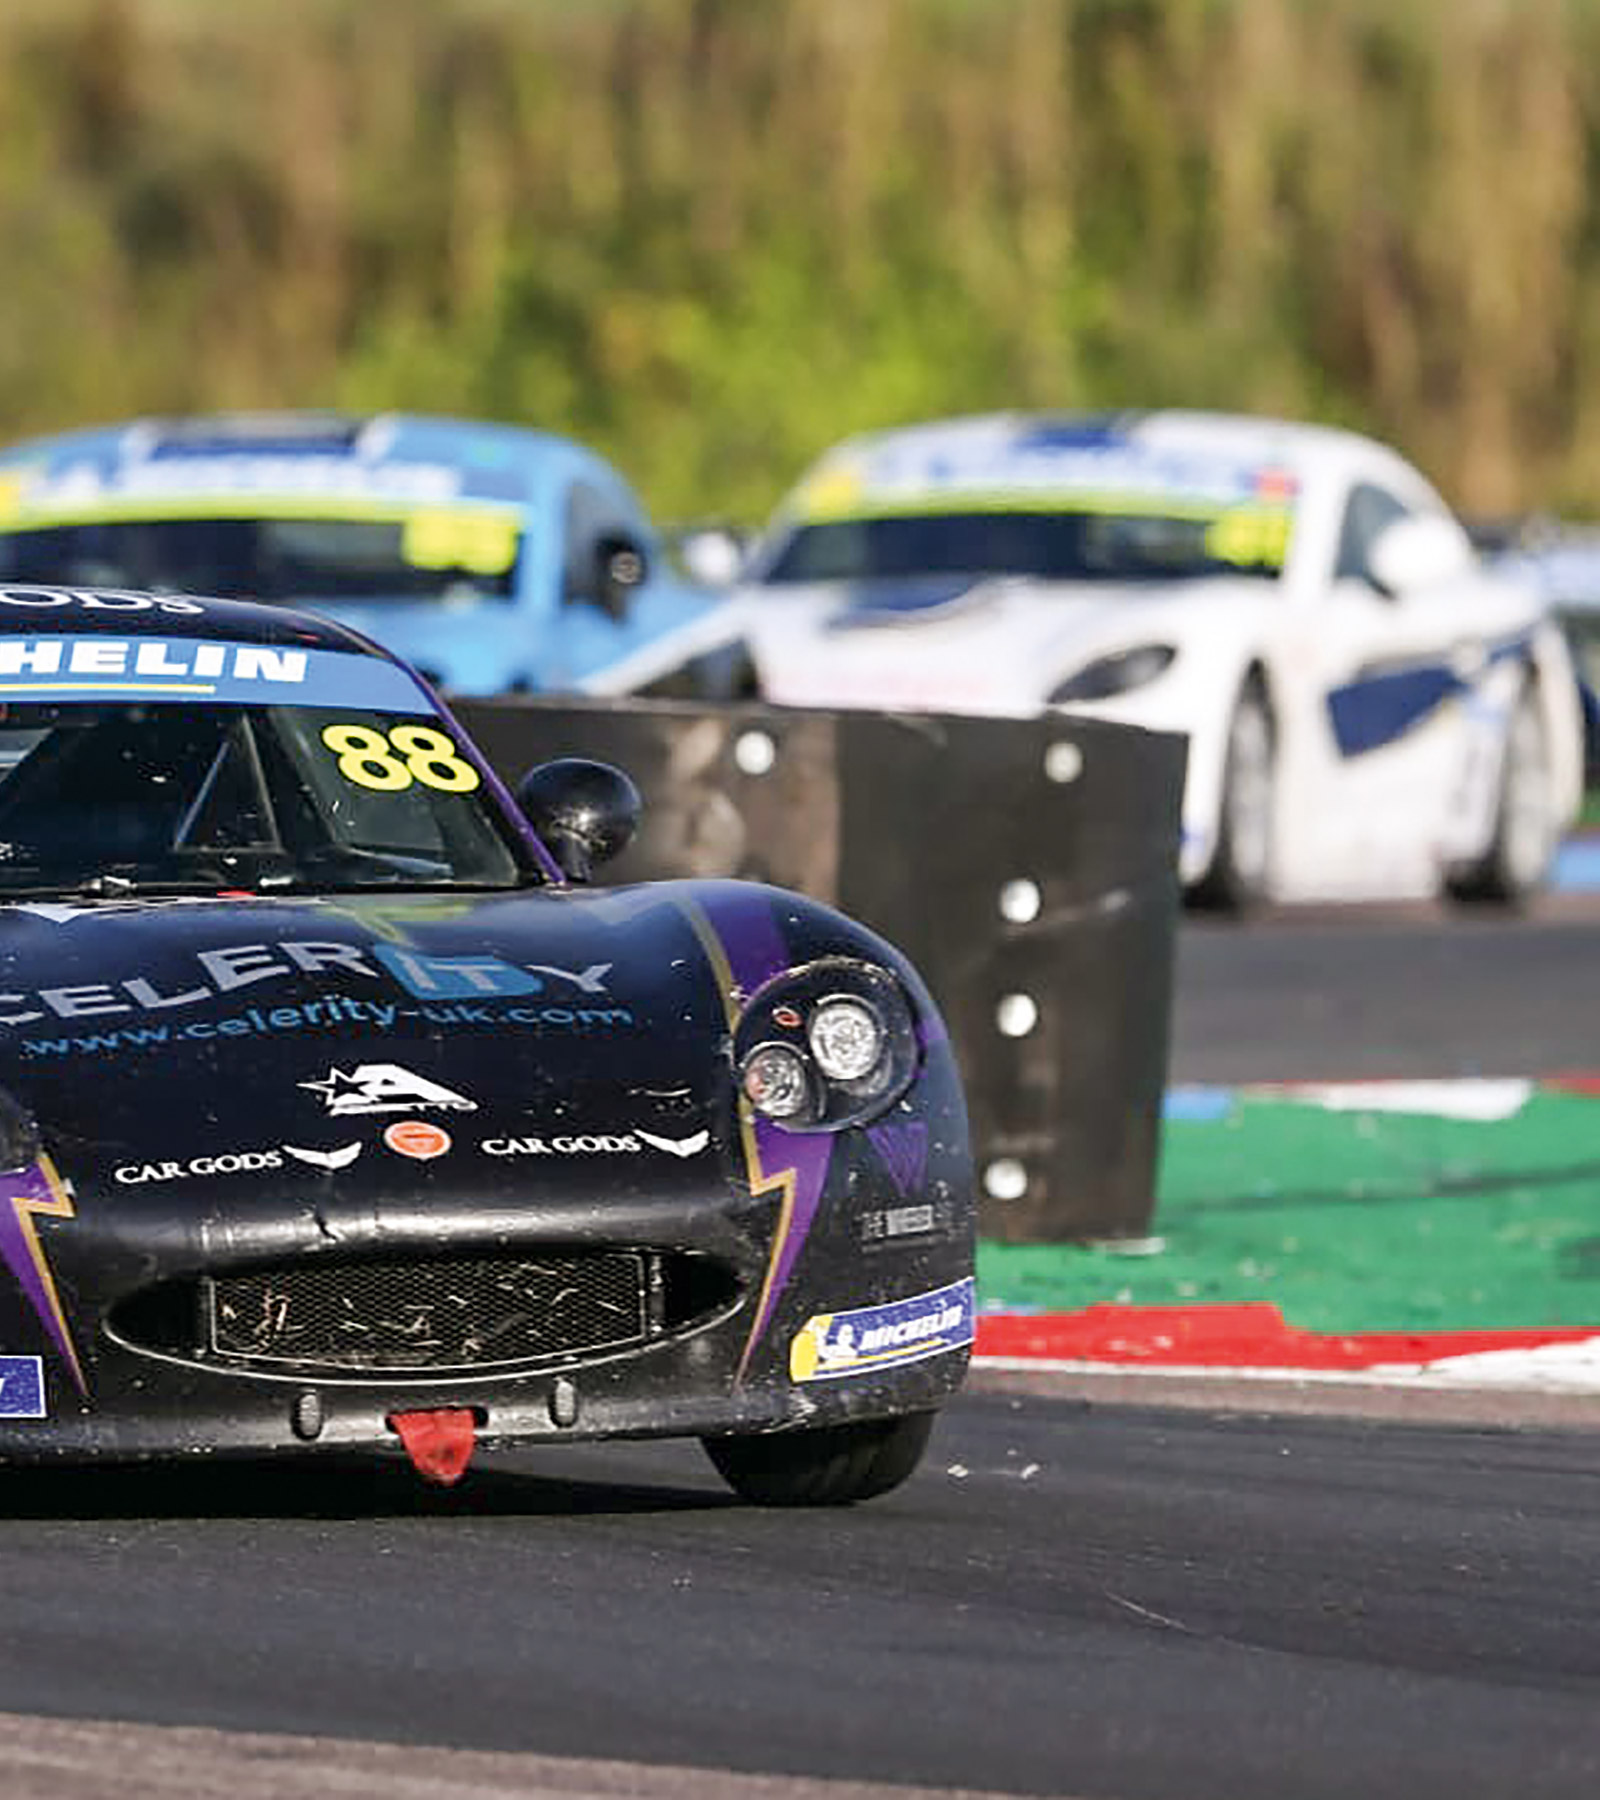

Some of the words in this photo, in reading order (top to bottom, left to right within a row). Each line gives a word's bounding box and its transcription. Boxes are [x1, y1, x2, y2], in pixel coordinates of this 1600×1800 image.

[321, 724, 481, 793] 88
[22, 990, 634, 1058] www.celerity-uk.com
[114, 1160, 190, 1183] CAR
[189, 1151, 284, 1174] GODS
[482, 1138, 552, 1155] CAR
[552, 1134, 642, 1152] GODS
[859, 1304, 963, 1351] MICHELIN
